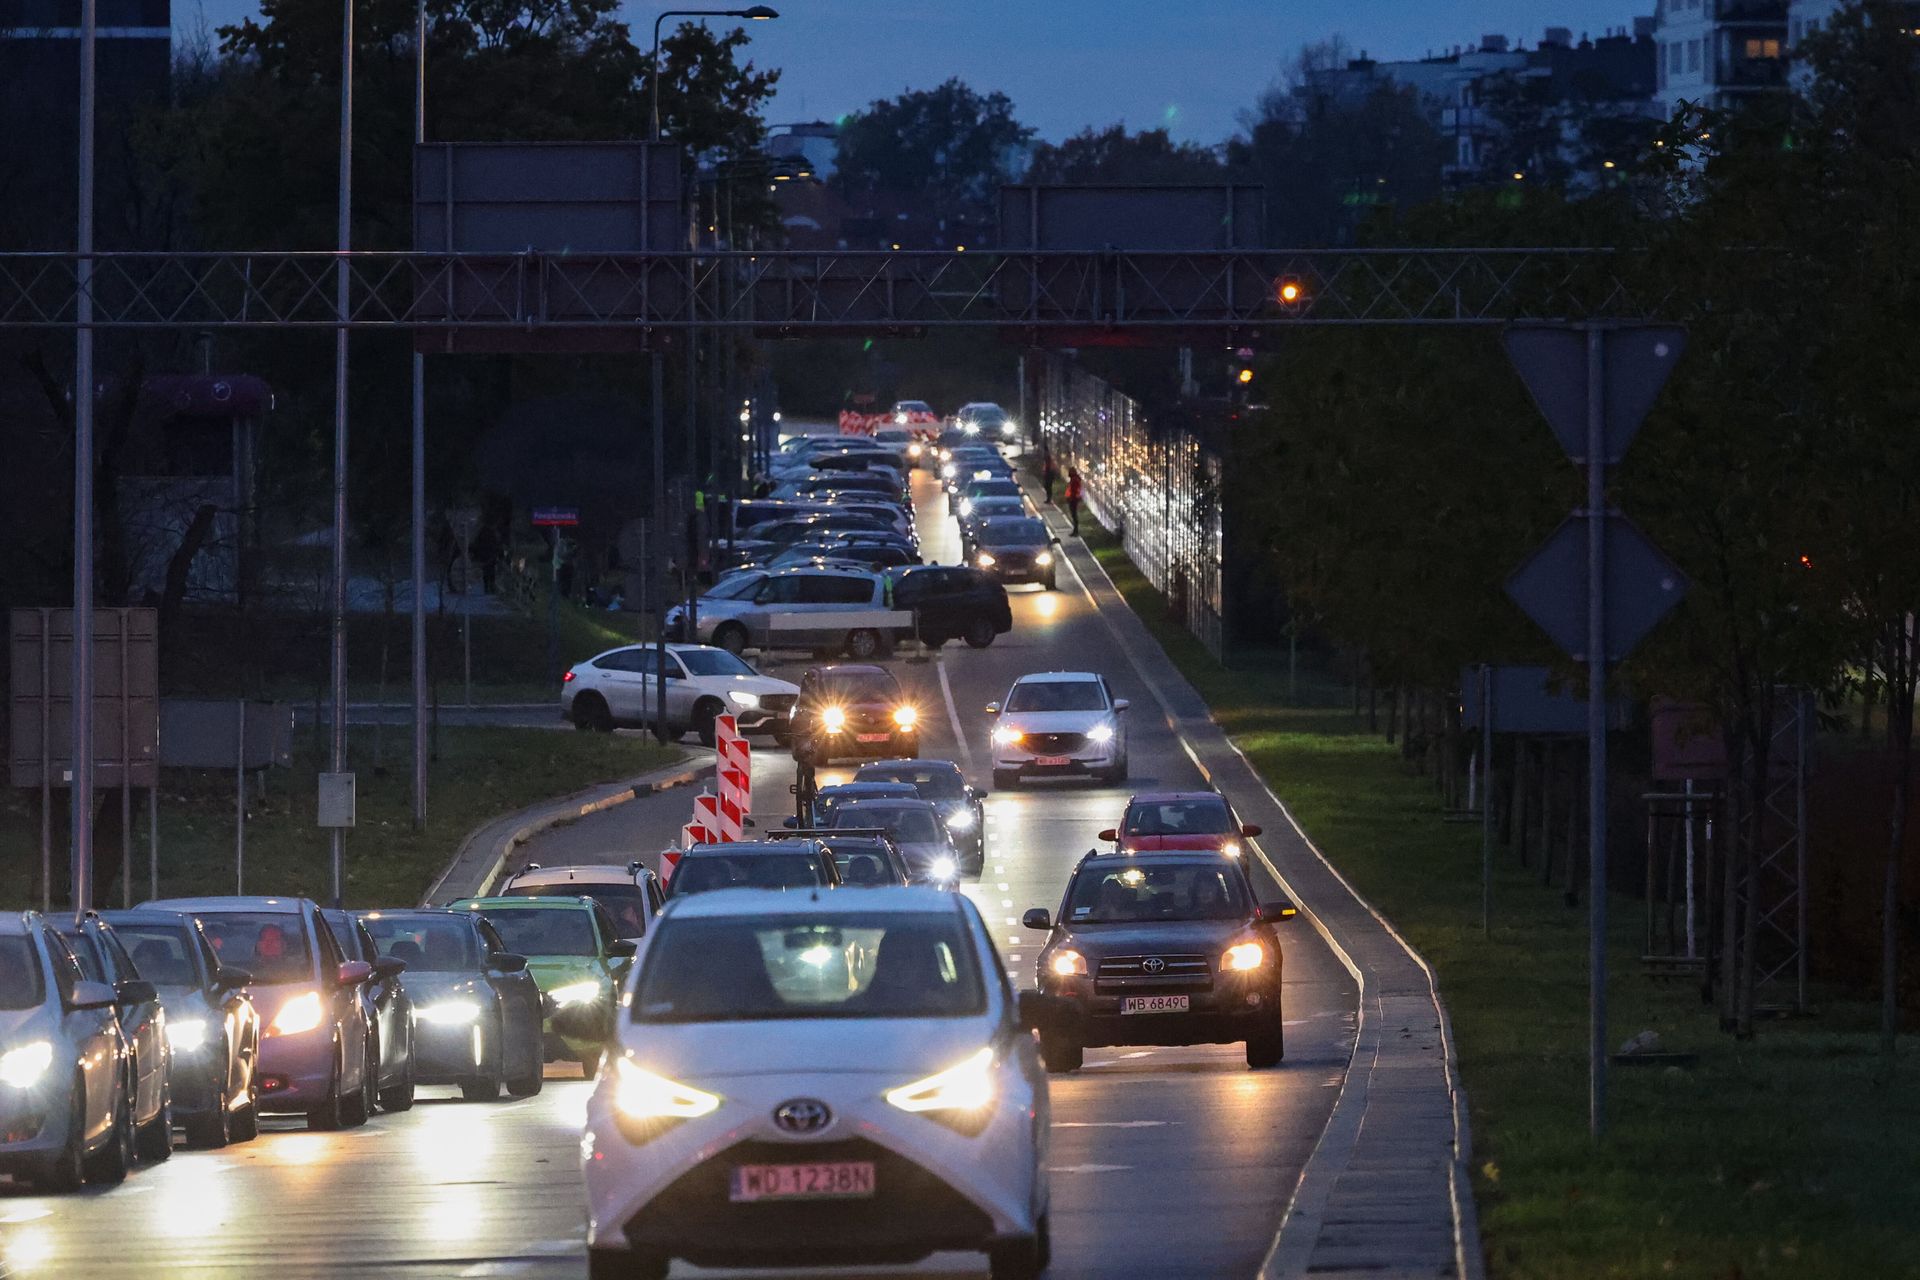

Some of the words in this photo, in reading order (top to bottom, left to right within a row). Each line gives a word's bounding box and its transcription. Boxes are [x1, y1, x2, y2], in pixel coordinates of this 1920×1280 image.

[1128, 998, 1146, 1010] WB
[1150, 996, 1187, 1010] 6849C
[791, 1166, 870, 1192] 1238N
